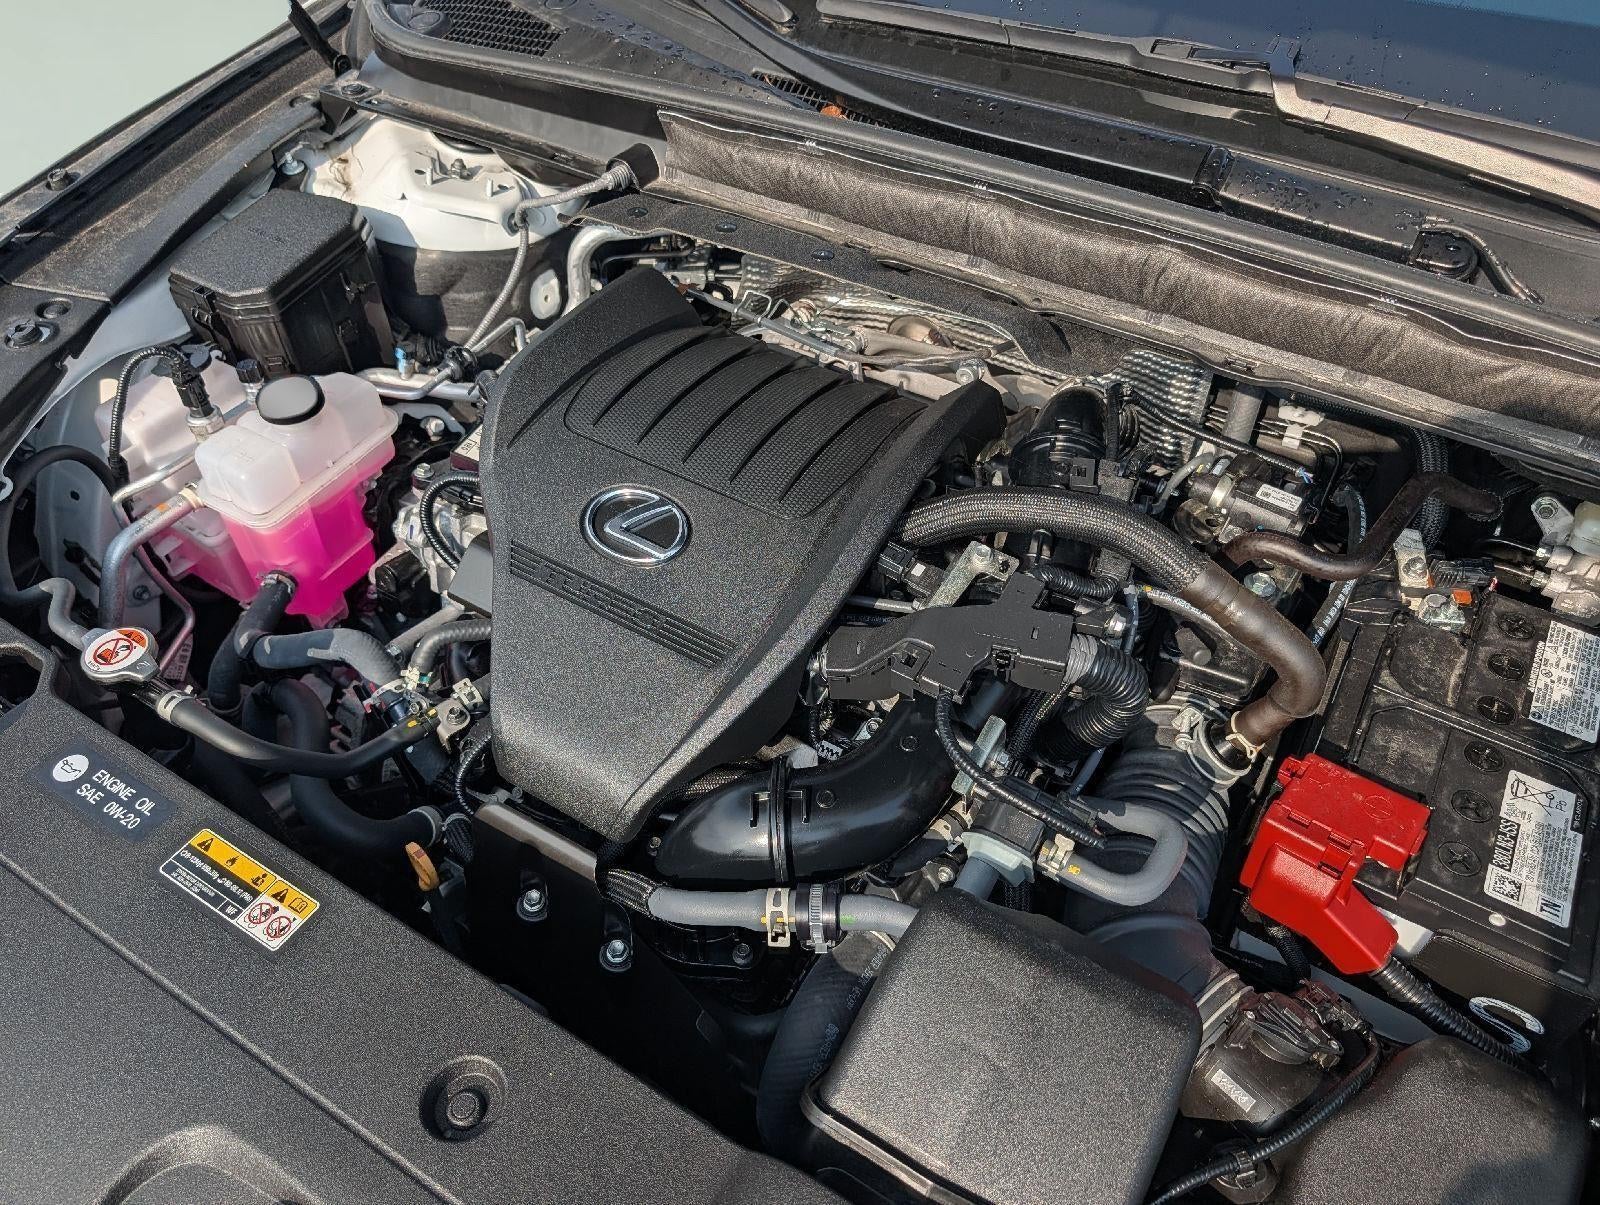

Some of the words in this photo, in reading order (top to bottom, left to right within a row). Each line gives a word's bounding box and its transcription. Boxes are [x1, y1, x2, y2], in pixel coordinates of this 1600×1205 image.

[76, 783, 105, 804] SAE
[103, 801, 141, 829] 0W-20
[92, 769, 136, 801] ENGINE
[134, 797, 156, 816] OIL
[1539, 898, 1562, 919] TN
